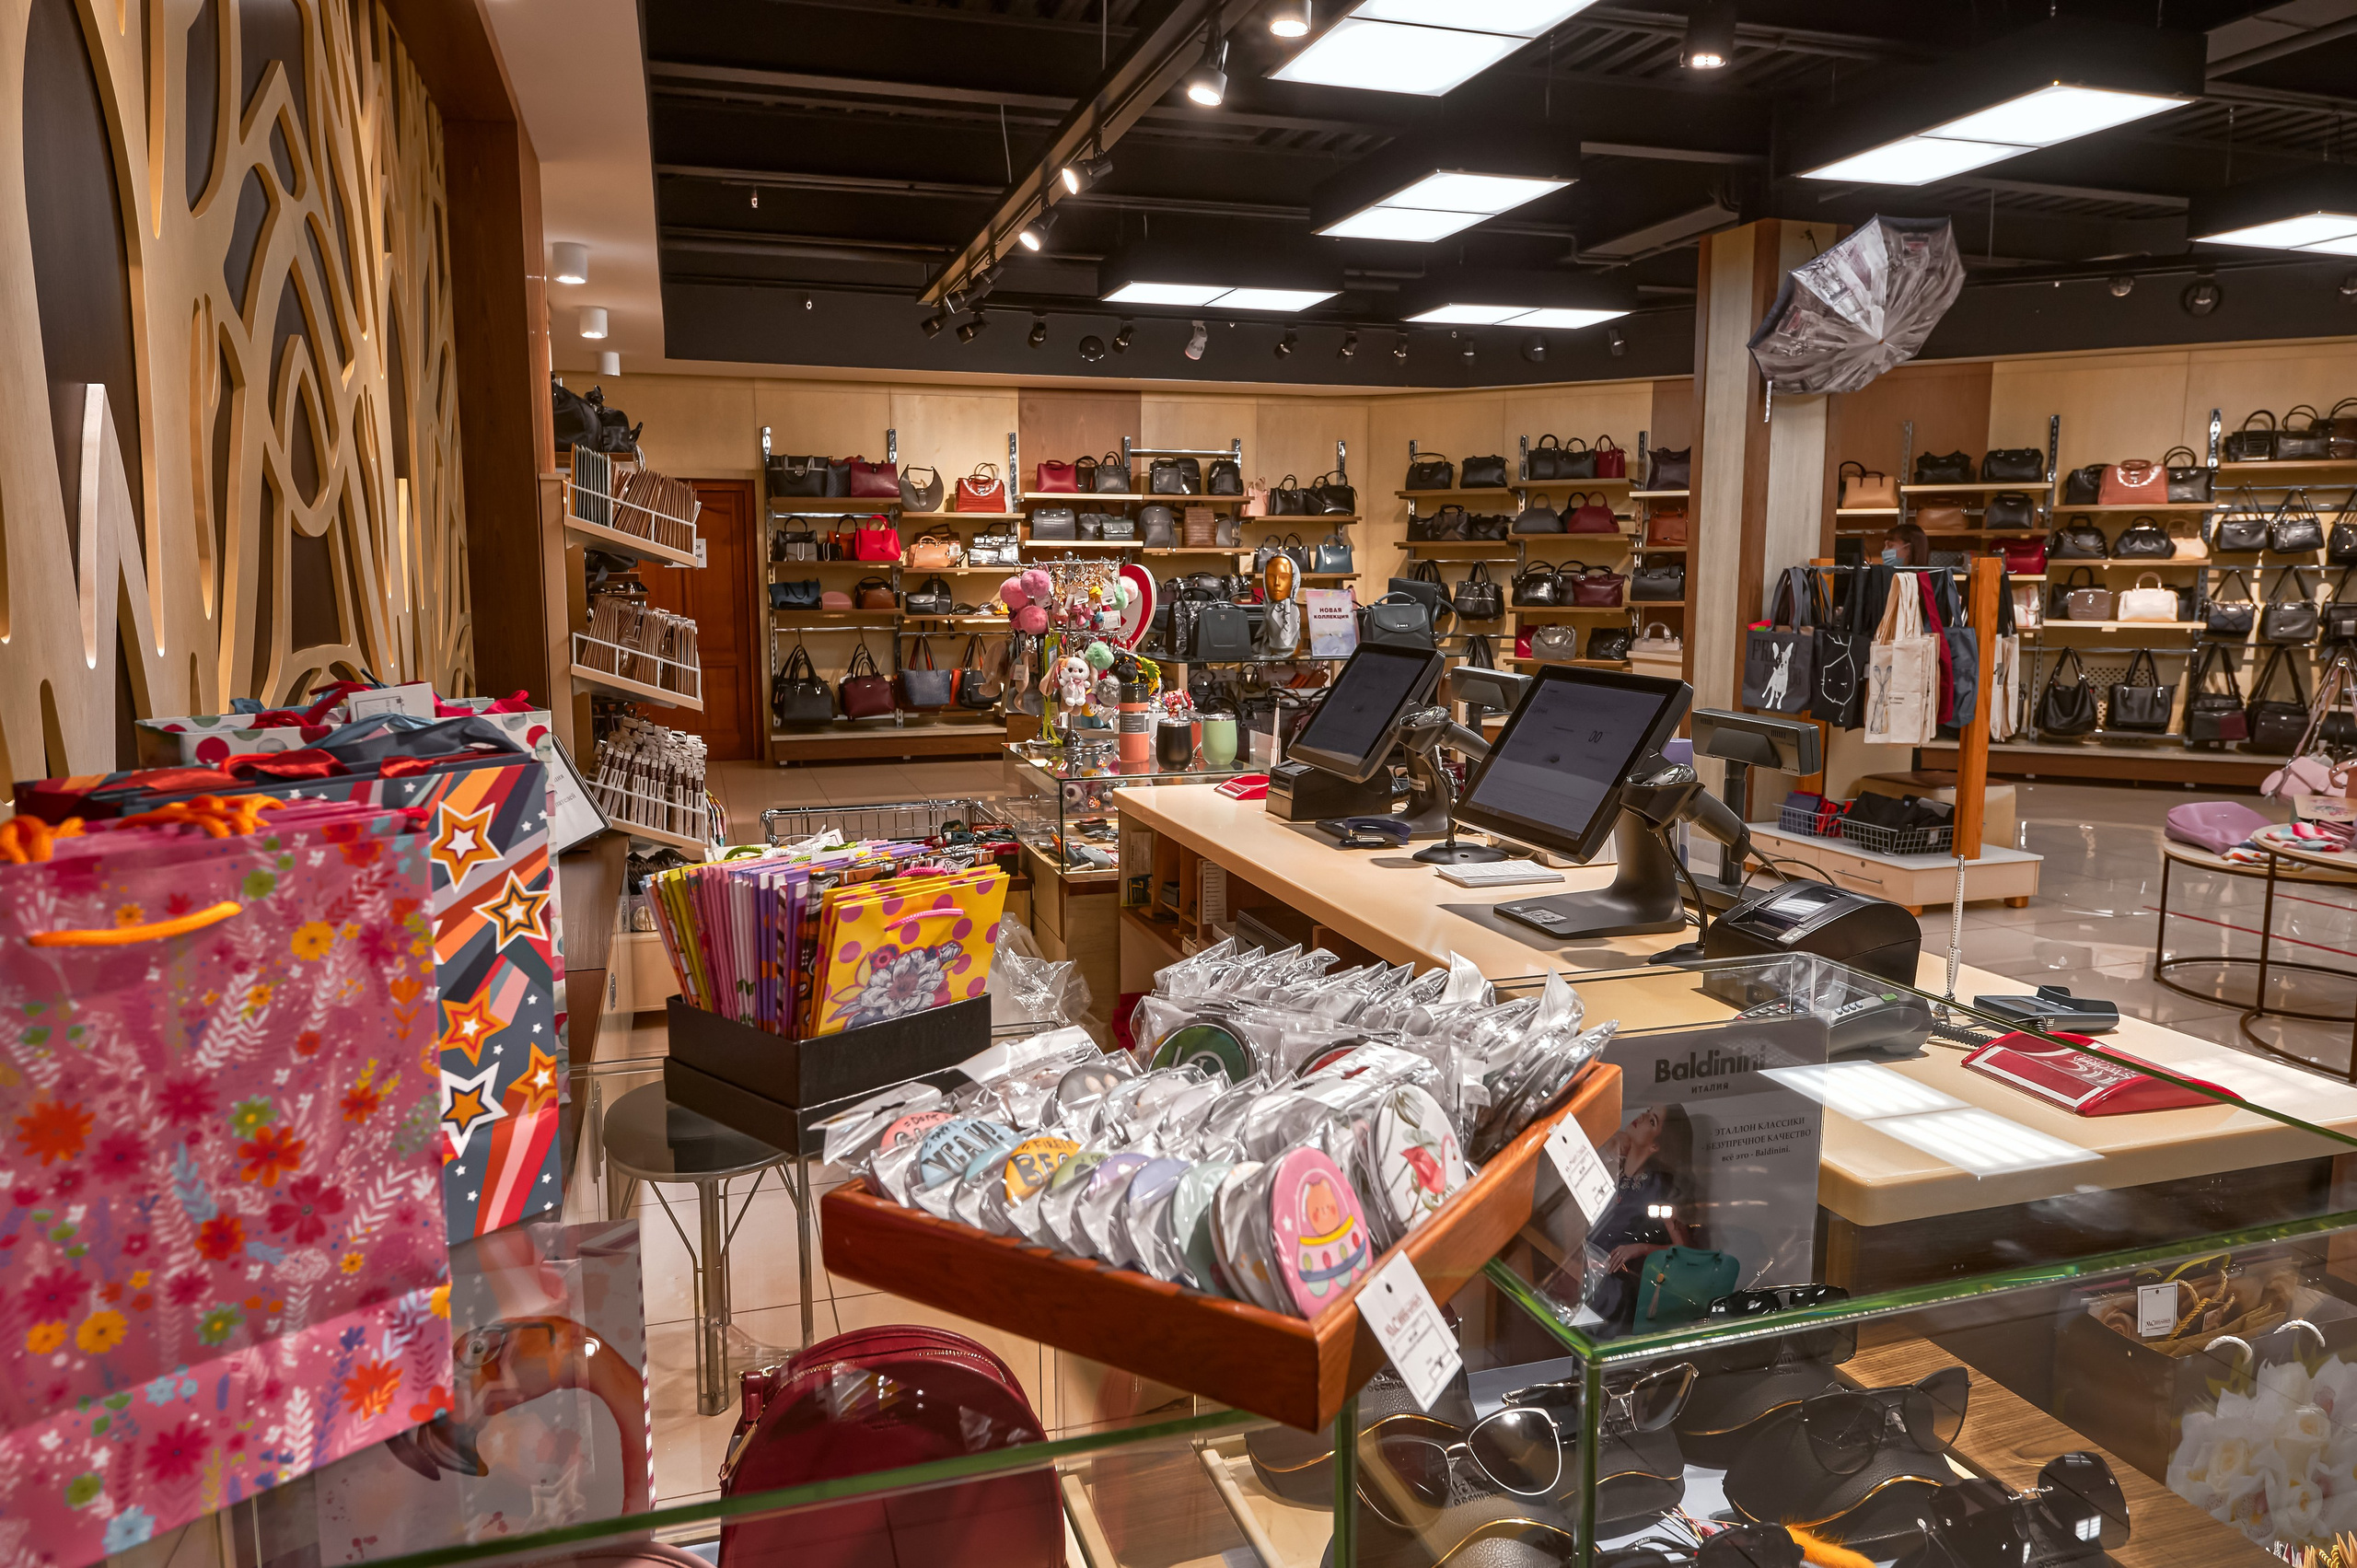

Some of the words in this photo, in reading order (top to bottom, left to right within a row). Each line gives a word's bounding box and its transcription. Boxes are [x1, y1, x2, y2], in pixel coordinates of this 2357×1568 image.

[1655, 1044, 1766, 1083] Baldinini
[1691, 1083, 1729, 1094] ИТАЛИЯ
[1714, 1123, 1756, 1136] ЭТАЛЛОН
[1758, 1117, 1805, 1130] КЛАССИКИ
[1706, 1135, 1766, 1151] БЕЗУПРЕЧНОЕ
[1767, 1129, 1812, 1143] КАЧЕСТВО
[1755, 1144, 1791, 1157] Baldinini.
